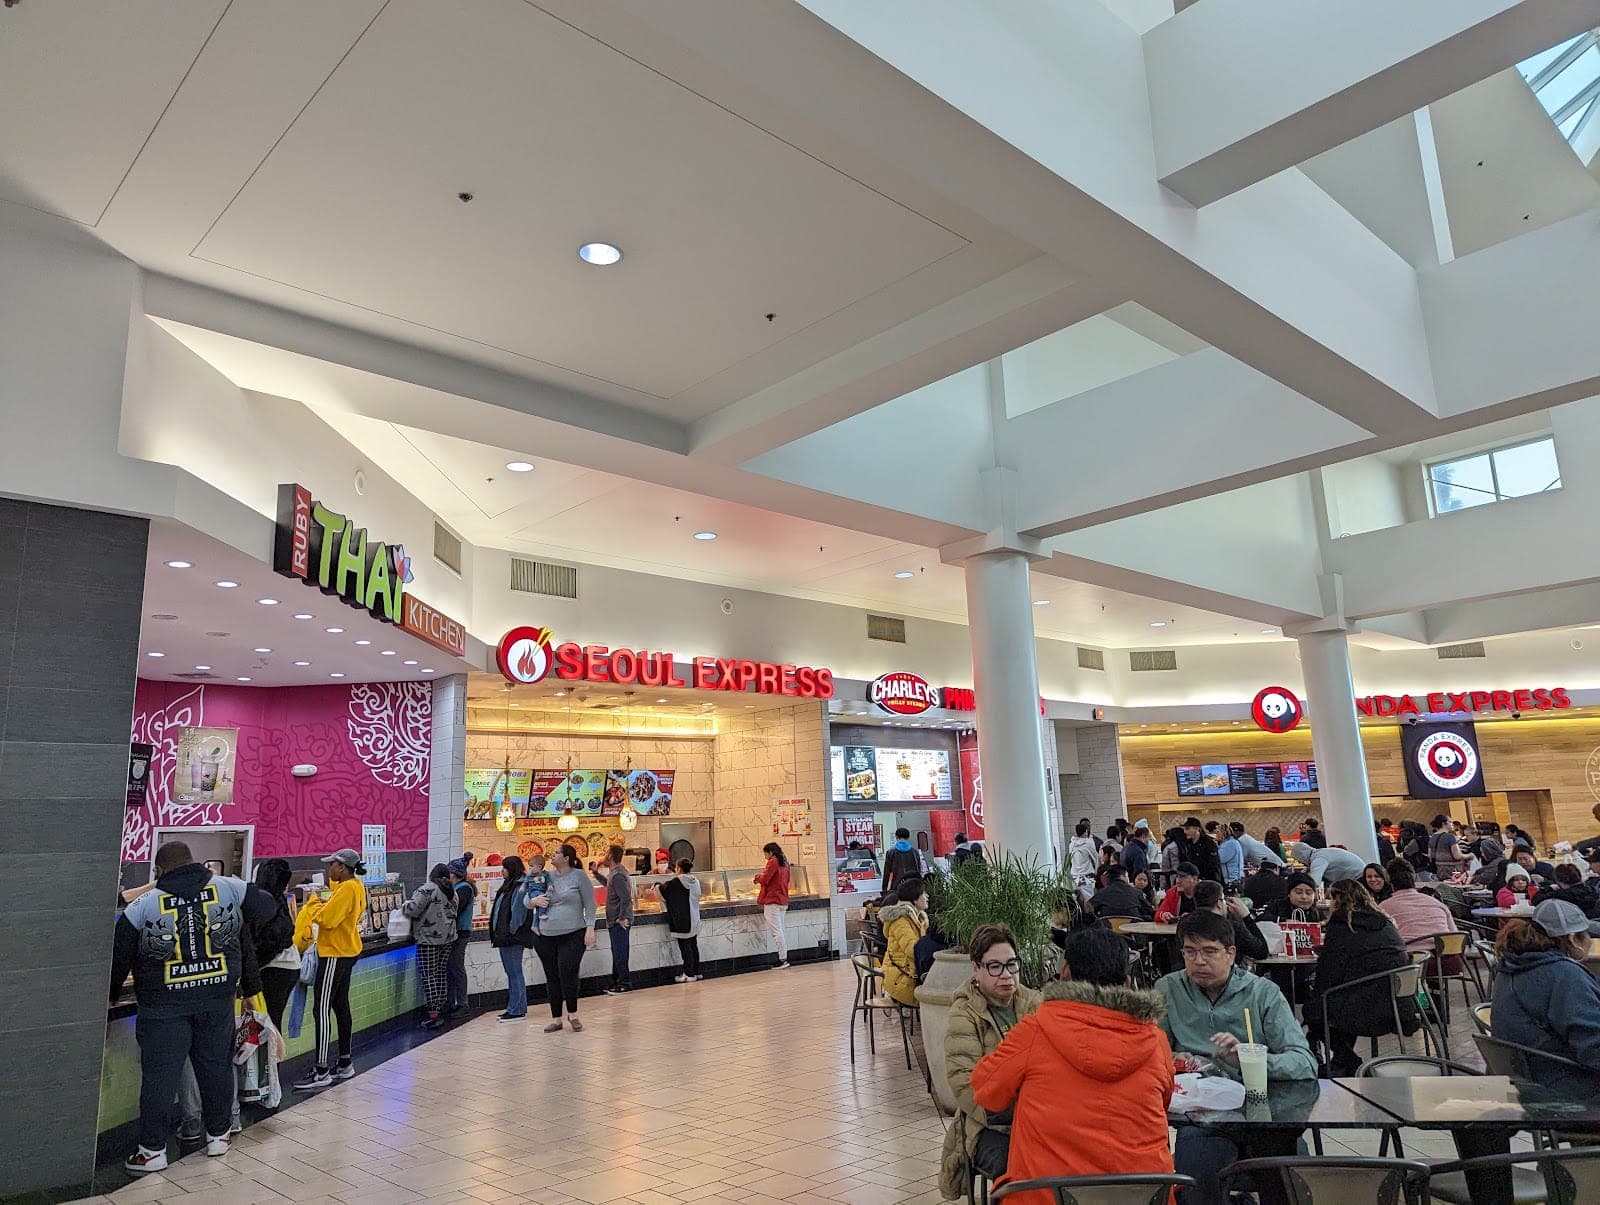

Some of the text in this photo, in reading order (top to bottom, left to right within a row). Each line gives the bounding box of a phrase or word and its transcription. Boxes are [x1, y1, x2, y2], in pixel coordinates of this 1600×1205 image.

[293, 493, 309, 570] RUBY
[313, 501, 408, 624] THAI
[409, 599, 464, 651] KITCHEN
[555, 643, 835, 699] SEOUL EXPRESS
[872, 679, 940, 707] CHARLEYS
[1356, 688, 1571, 716] NDA EXPRESS
[1420, 733, 1473, 758] PANDA EXPRESS
[846, 822, 874, 833] STEAK
[846, 835, 874, 846] WORLD
[170, 891, 209, 907] FAH
[171, 959, 220, 976] FAMILY
[167, 975, 228, 991] TRADITION
